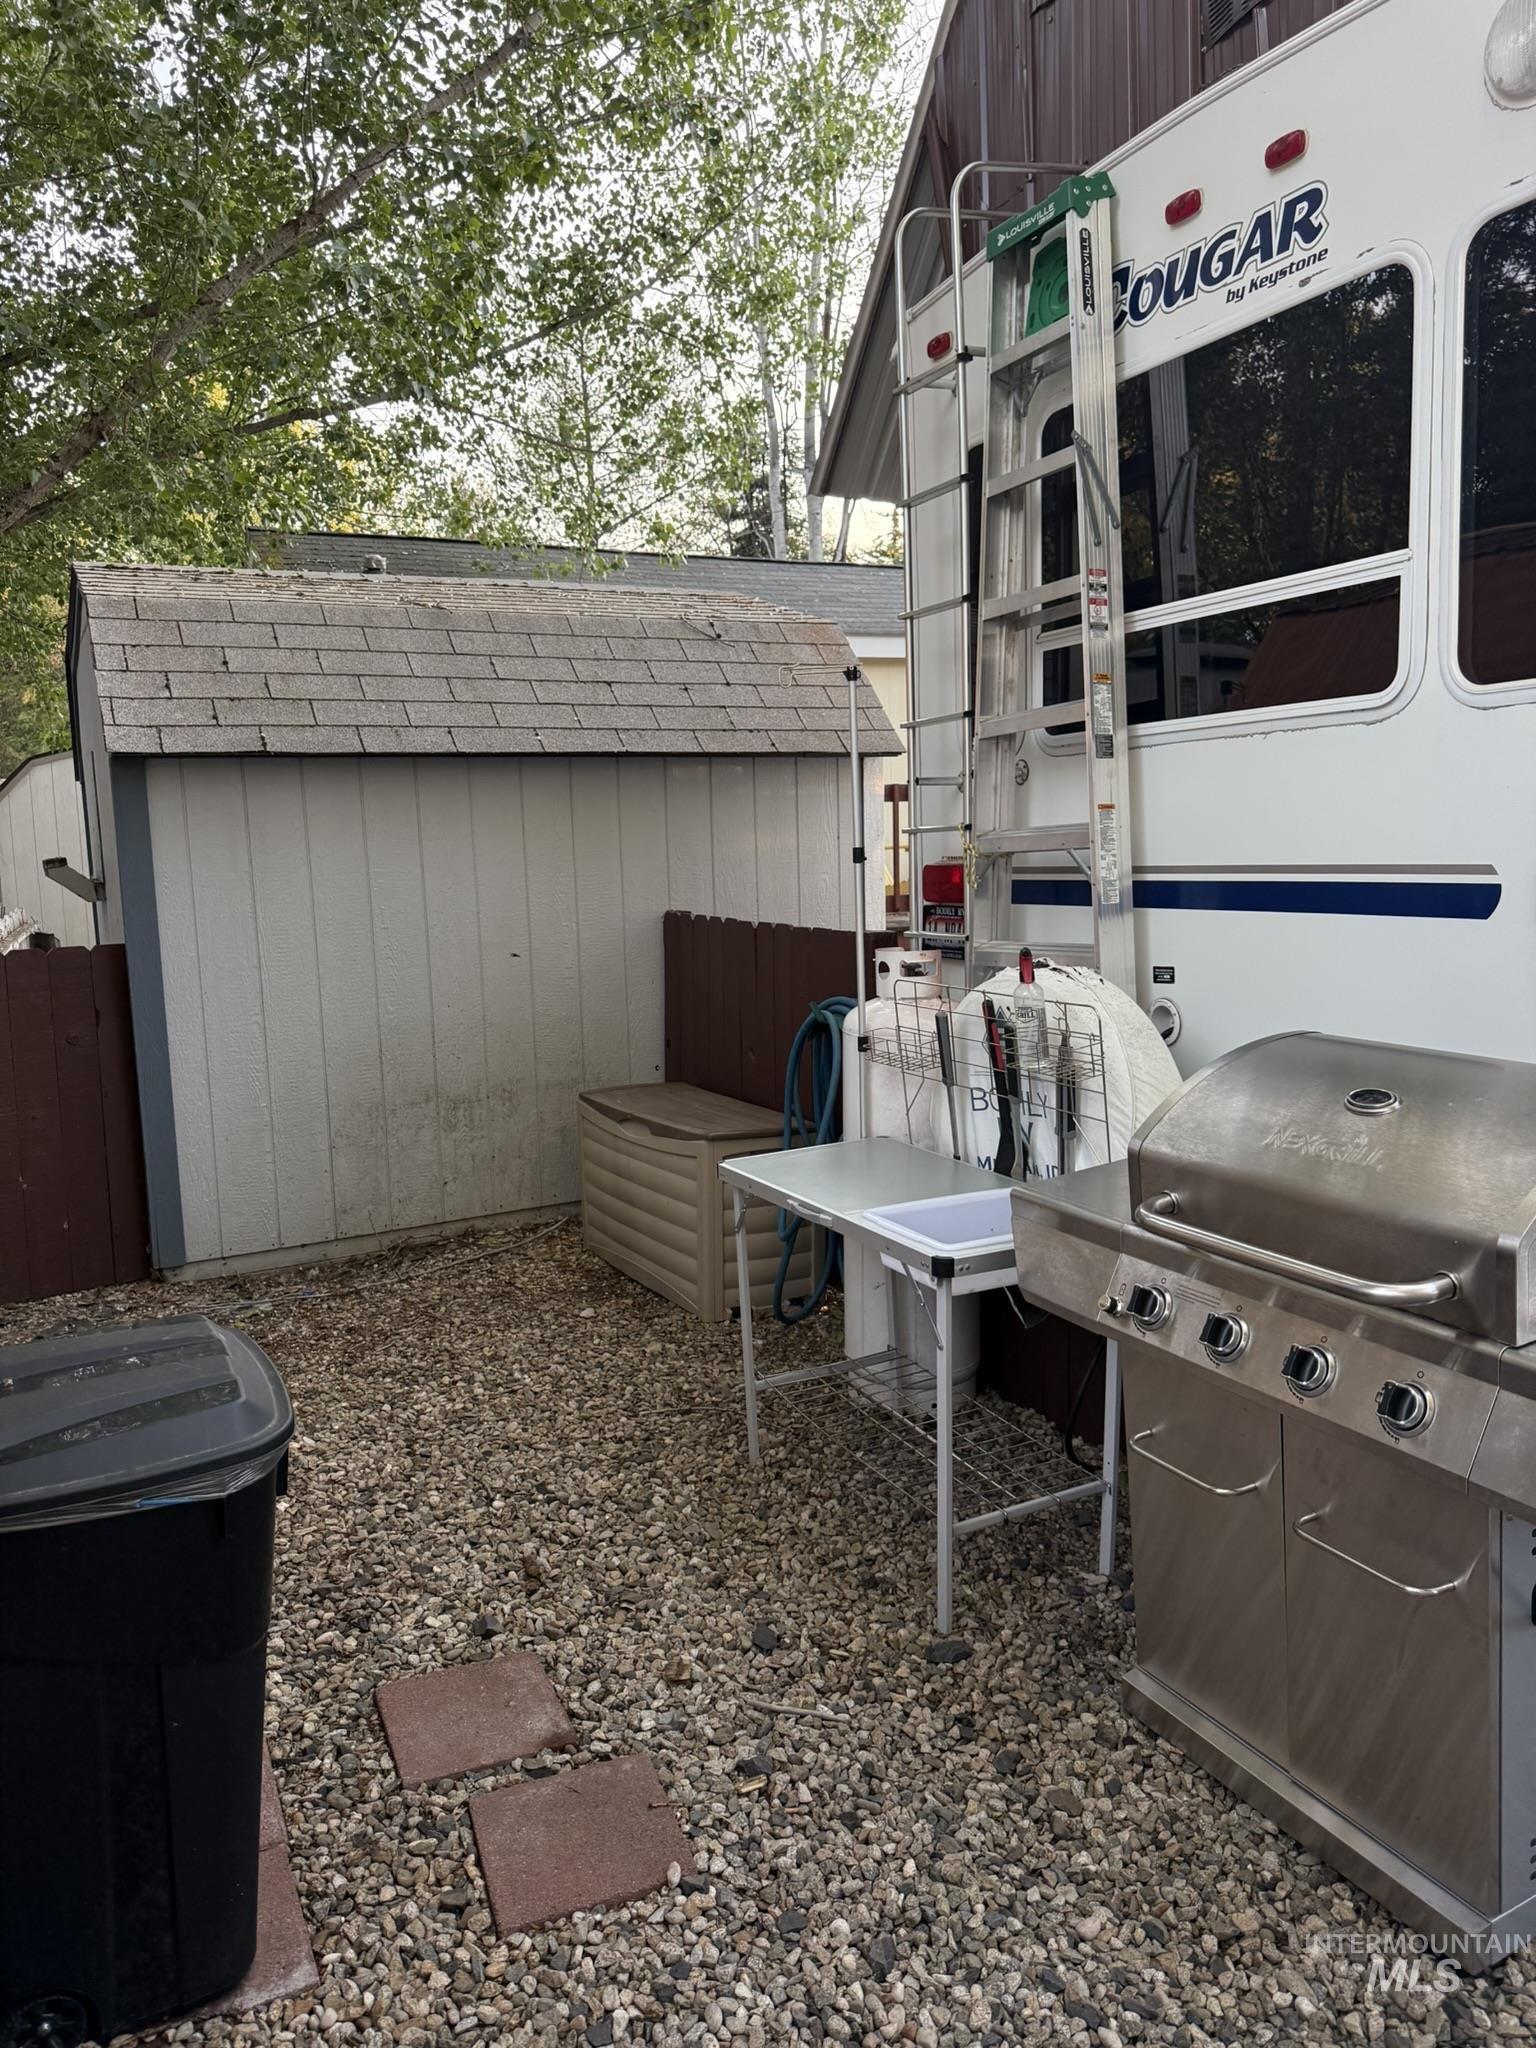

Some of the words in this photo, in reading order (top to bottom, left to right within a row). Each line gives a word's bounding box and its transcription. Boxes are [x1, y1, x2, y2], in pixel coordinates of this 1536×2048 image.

[1005, 202, 1055, 240] LOUISVILLE
[1082, 229, 1093, 304] LOUISVILLE
[1112, 181, 1329, 336] COUGAR
[1225, 285, 1246, 304] by
[1249, 248, 1328, 295] Keystone
